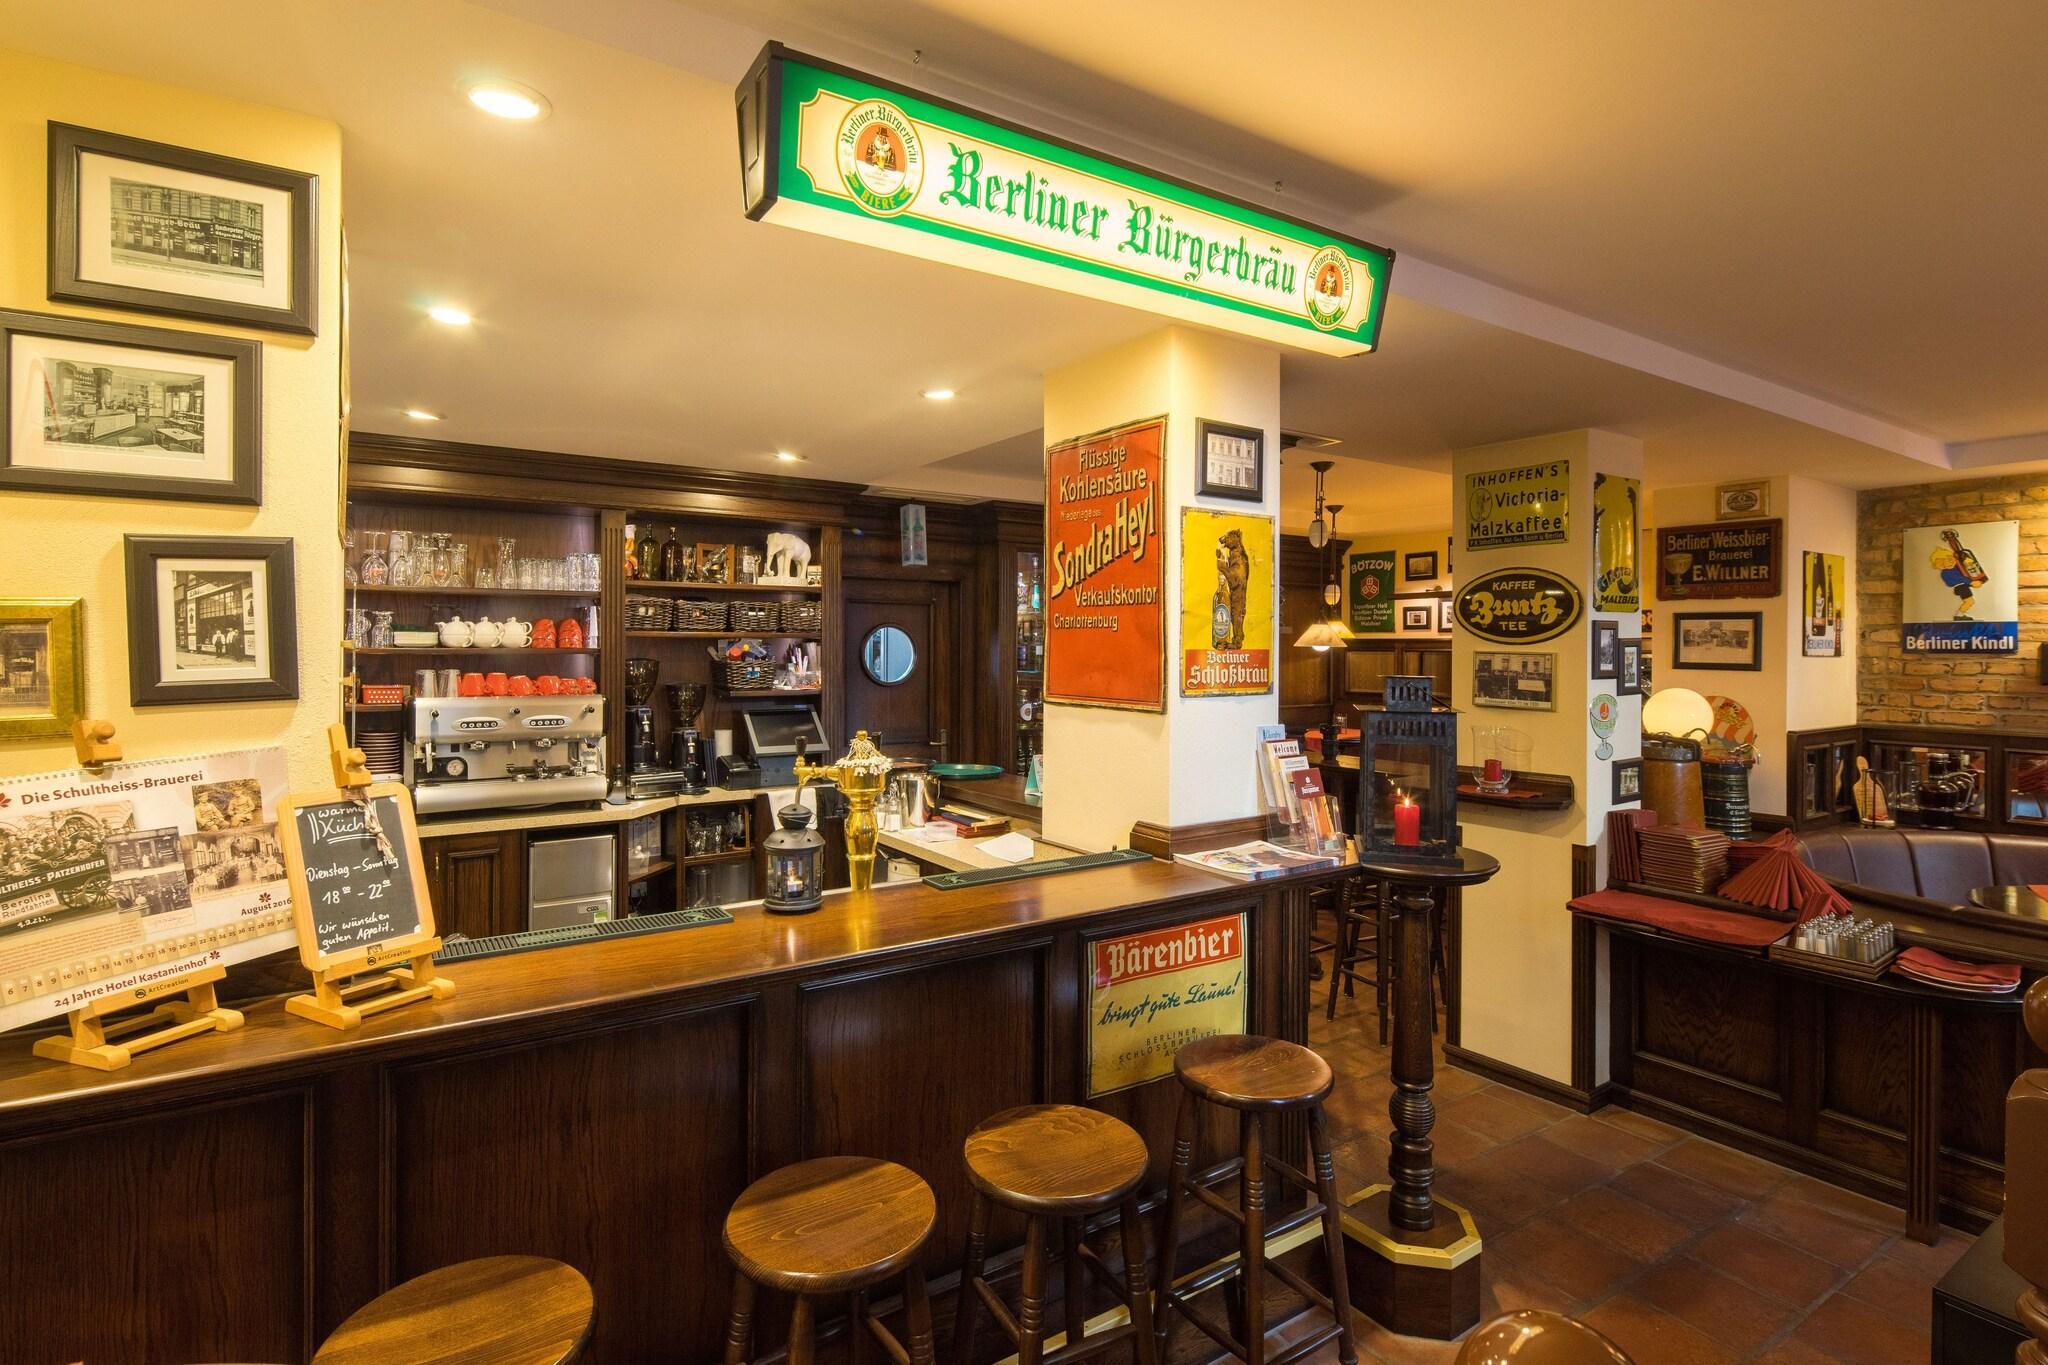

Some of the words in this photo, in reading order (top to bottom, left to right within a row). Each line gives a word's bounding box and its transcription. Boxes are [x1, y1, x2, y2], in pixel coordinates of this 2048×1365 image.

[841, 108, 874, 149] Berliner
[875, 104, 918, 164] Bürgerbräu
[860, 190, 897, 209] BIERE
[938, 141, 1110, 242] Berliner
[1117, 198, 1298, 295] Bürgerbräu
[1079, 444, 1126, 474] Flüssige
[1060, 467, 1147, 504] Kohlensäure
[1472, 464, 1558, 488] INHOFFEN'S
[1495, 488, 1566, 508] Victoria-
[1470, 516, 1562, 538] Malzkaffee
[1667, 533, 1711, 552] Berliner
[1711, 530, 1770, 549] Weissbier-
[1708, 549, 1753, 561] Brauerei
[1351, 559, 1394, 574] BÖTZOW
[1074, 583, 1158, 607] Verkaufskontor
[1492, 580, 1536, 591] KAFFEE
[1469, 591, 1564, 626] Zuntz
[1054, 613, 1119, 631] Charlottenburg
[1499, 621, 1528, 631] TEE
[1906, 636, 1968, 651] Berliner
[1971, 635, 2014, 650] Kindl
[1206, 650, 1250, 664] Berliner
[1186, 663, 1268, 689] Schloßbräu
[1272, 743, 1297, 754] Welcome
[21, 792, 50, 805] Die
[53, 770, 204, 800] Schultheiss-Brauerei
[306, 862, 350, 882] Dienstag
[1, 892, 51, 911] Berolina
[240, 902, 272, 916] August
[273, 897, 292, 908] 2016
[318, 921, 338, 935] Wir
[341, 912, 390, 930] wünschen
[321, 934, 352, 951] guten
[1106, 927, 1234, 979] Bärenbier
[54, 997, 70, 1008] 24
[71, 986, 104, 1004] Jahre
[105, 975, 137, 993] Hotel
[138, 957, 208, 983] Kastanienhof
[148, 978, 189, 993] ArtCreation
[1098, 994, 1150, 1028] bringt
[1146, 1027, 1197, 1046] BERLINER
